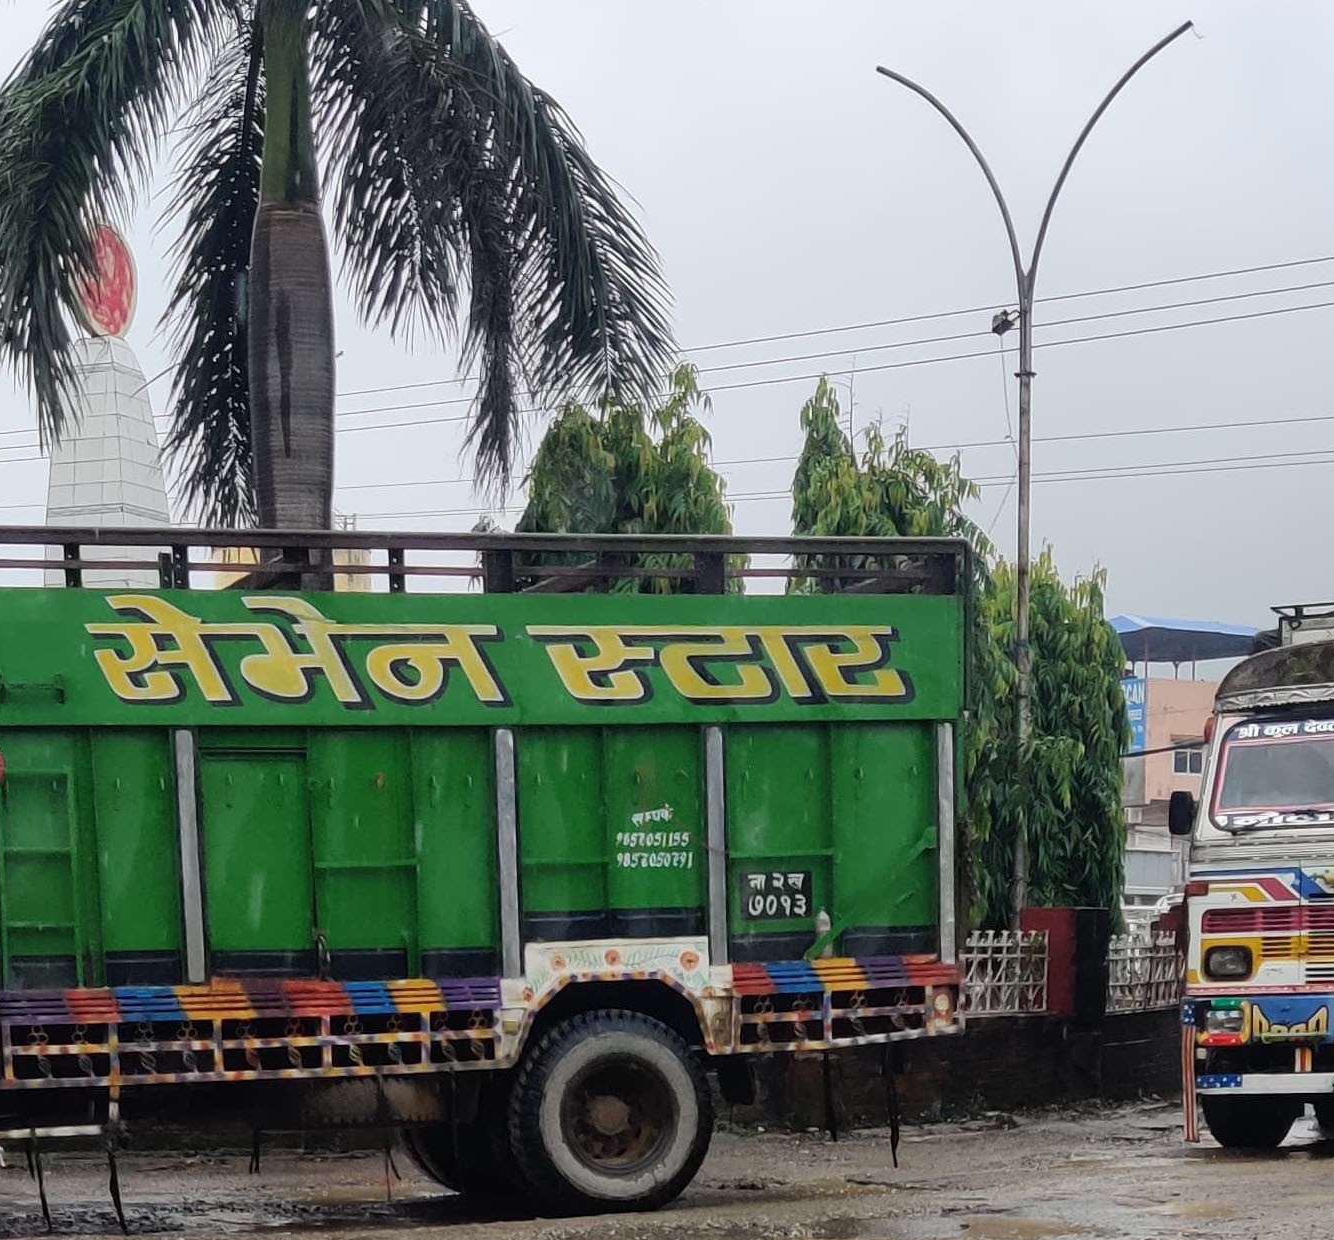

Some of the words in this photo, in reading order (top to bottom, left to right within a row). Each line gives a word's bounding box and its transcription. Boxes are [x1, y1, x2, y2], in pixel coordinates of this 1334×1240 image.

[84, 596, 509, 705] सेभेन
[525, 625, 910, 703] स्टार
[748, 873, 767, 890] ना
[772, 874, 785, 889] २
[748, 895, 807, 917] ७०१३
